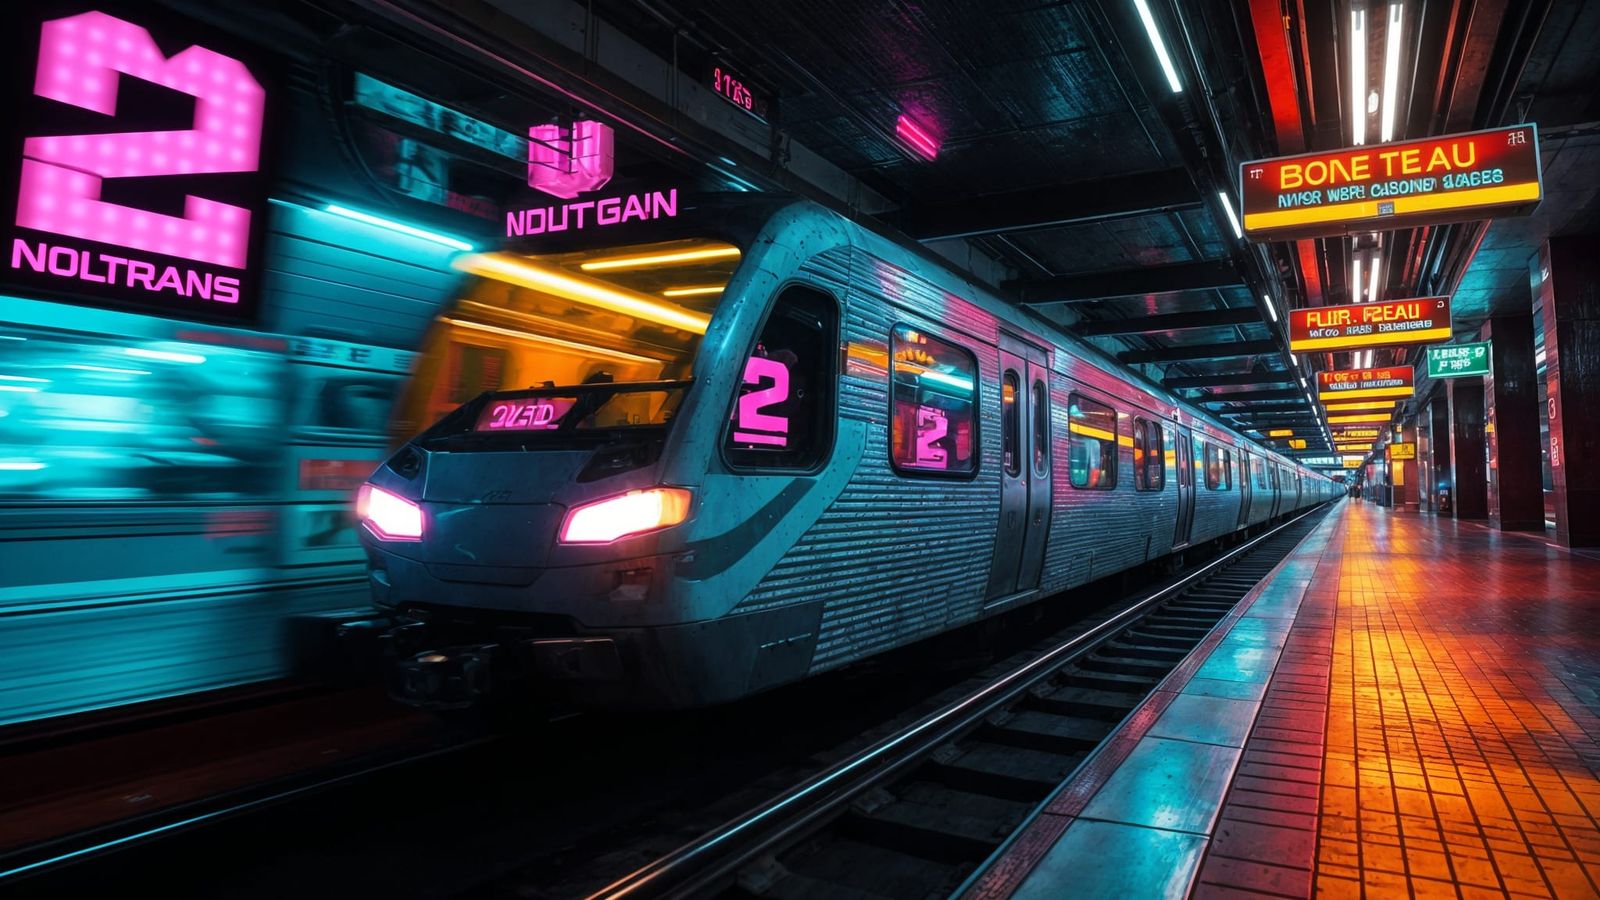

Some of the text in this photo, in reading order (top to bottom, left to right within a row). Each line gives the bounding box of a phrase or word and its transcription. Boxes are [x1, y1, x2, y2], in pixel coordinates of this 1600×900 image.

[1280, 154, 1370, 190] BONE
[11, 238, 241, 304] NOLTRANS
[739, 356, 790, 432] 2
